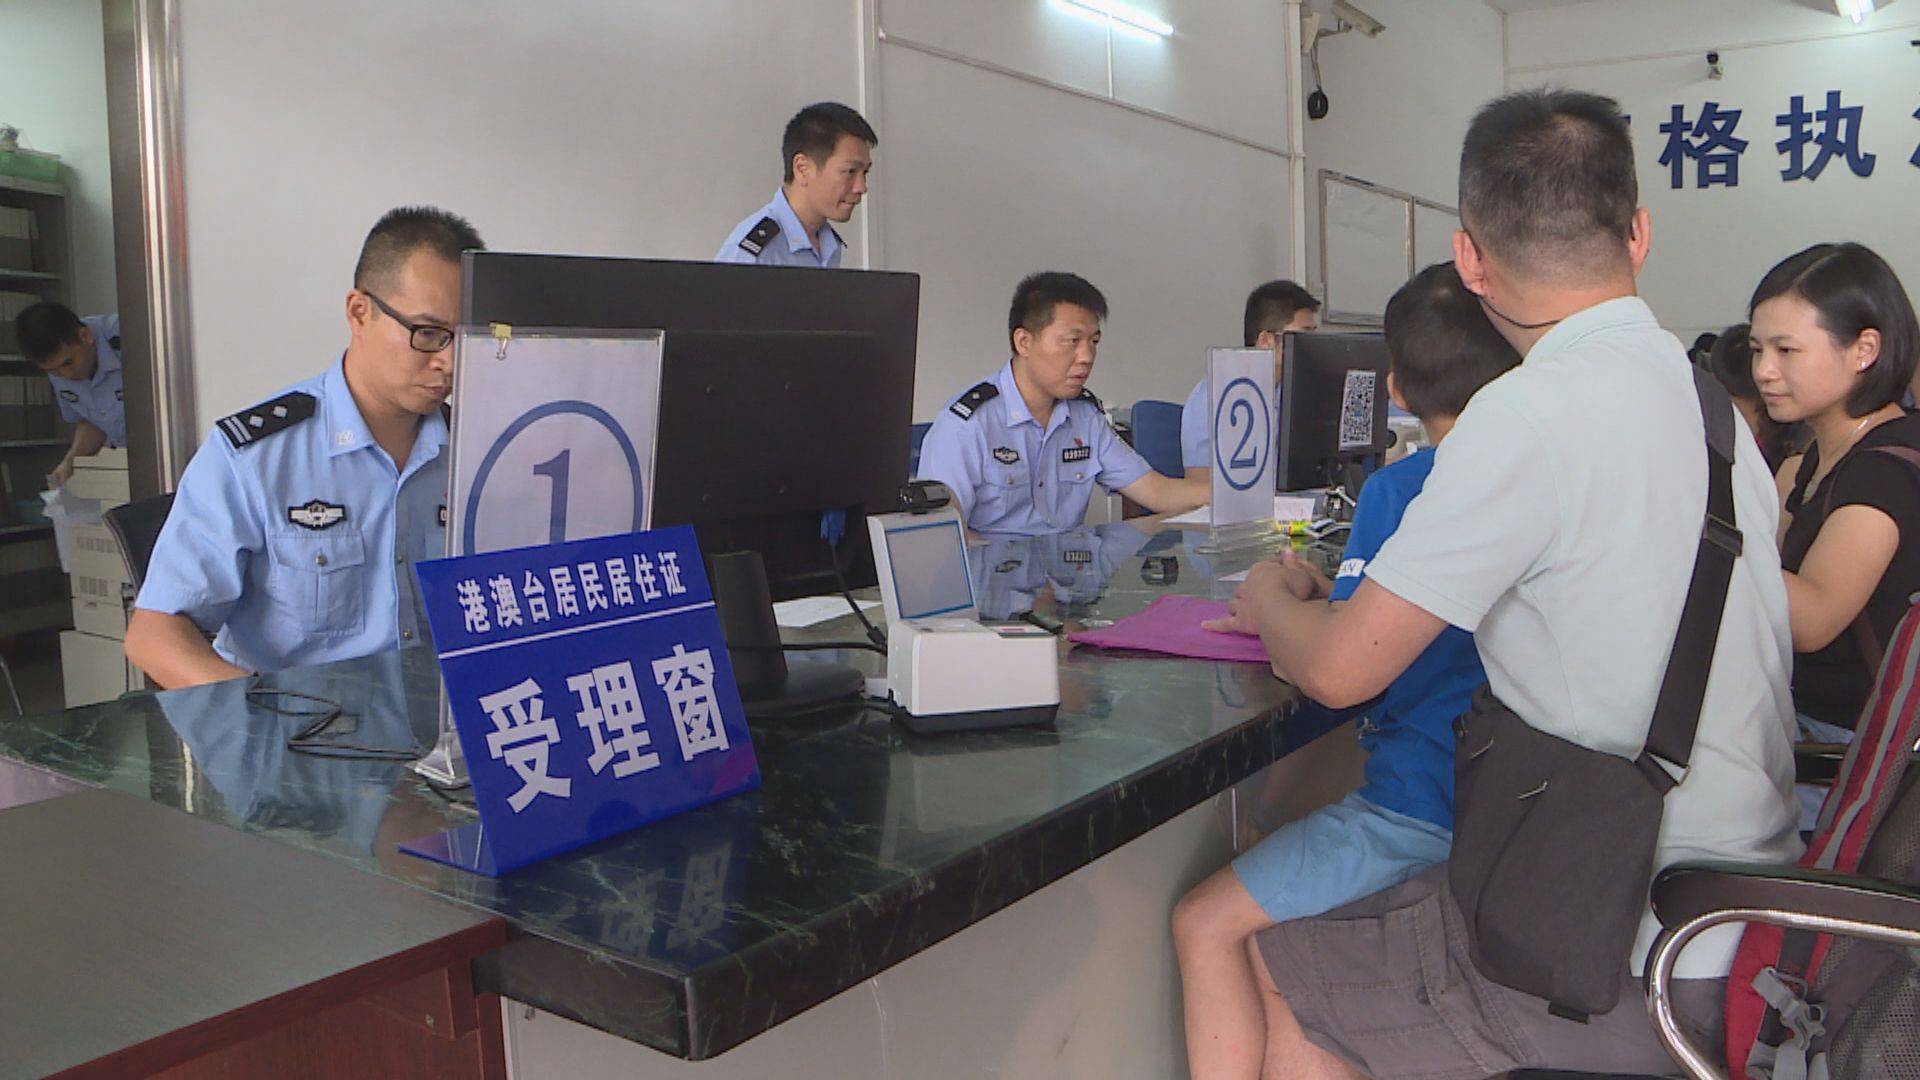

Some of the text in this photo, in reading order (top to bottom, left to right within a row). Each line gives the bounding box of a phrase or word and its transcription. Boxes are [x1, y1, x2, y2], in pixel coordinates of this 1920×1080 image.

[1625, 90, 1920, 188] 格执
[1230, 399, 1257, 469] 2
[533, 448, 570, 546] 1
[457, 551, 687, 633] 港澳台居民居住证
[478, 643, 730, 813] 受理窗
